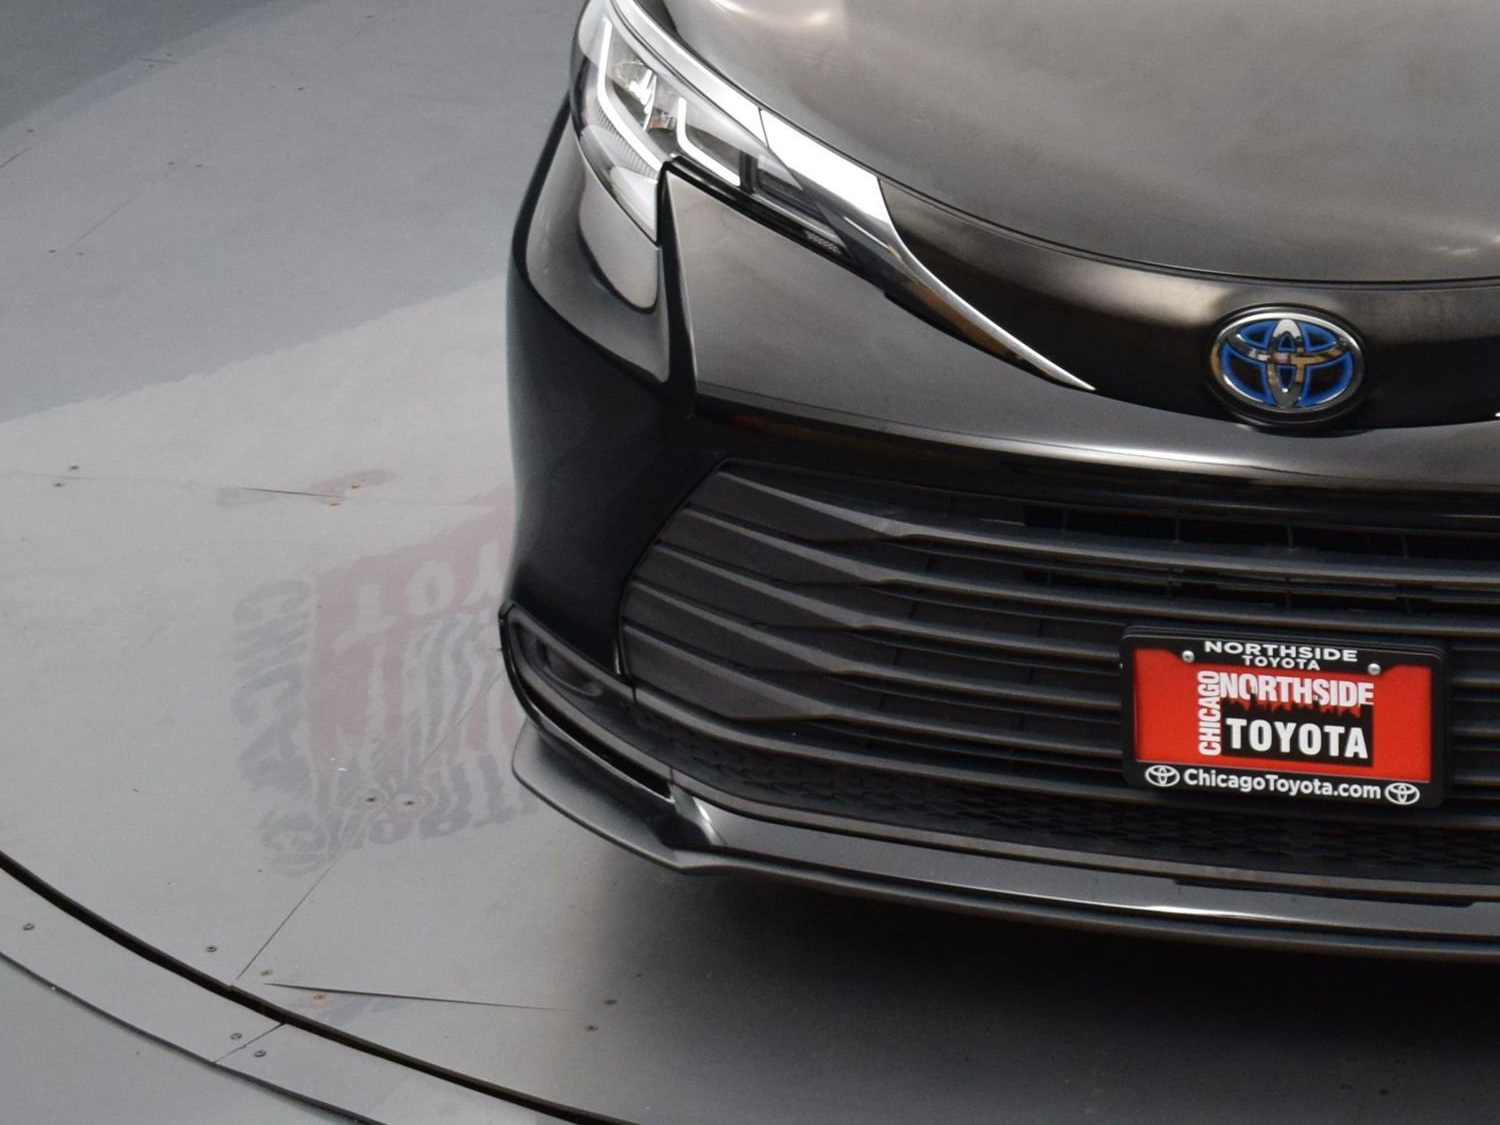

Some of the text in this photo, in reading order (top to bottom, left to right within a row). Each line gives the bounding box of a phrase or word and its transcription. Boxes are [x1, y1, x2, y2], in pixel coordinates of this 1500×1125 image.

[1204, 640, 1358, 662] NORTHSIDE
[1242, 654, 1320, 671] TOYOTA
[1219, 672, 1374, 708] NORTHSIDE
[1197, 670, 1222, 756] CHICAGO
[1225, 717, 1369, 759] TOYOTA
[1183, 768, 1382, 800] ChicagoToyota.com
